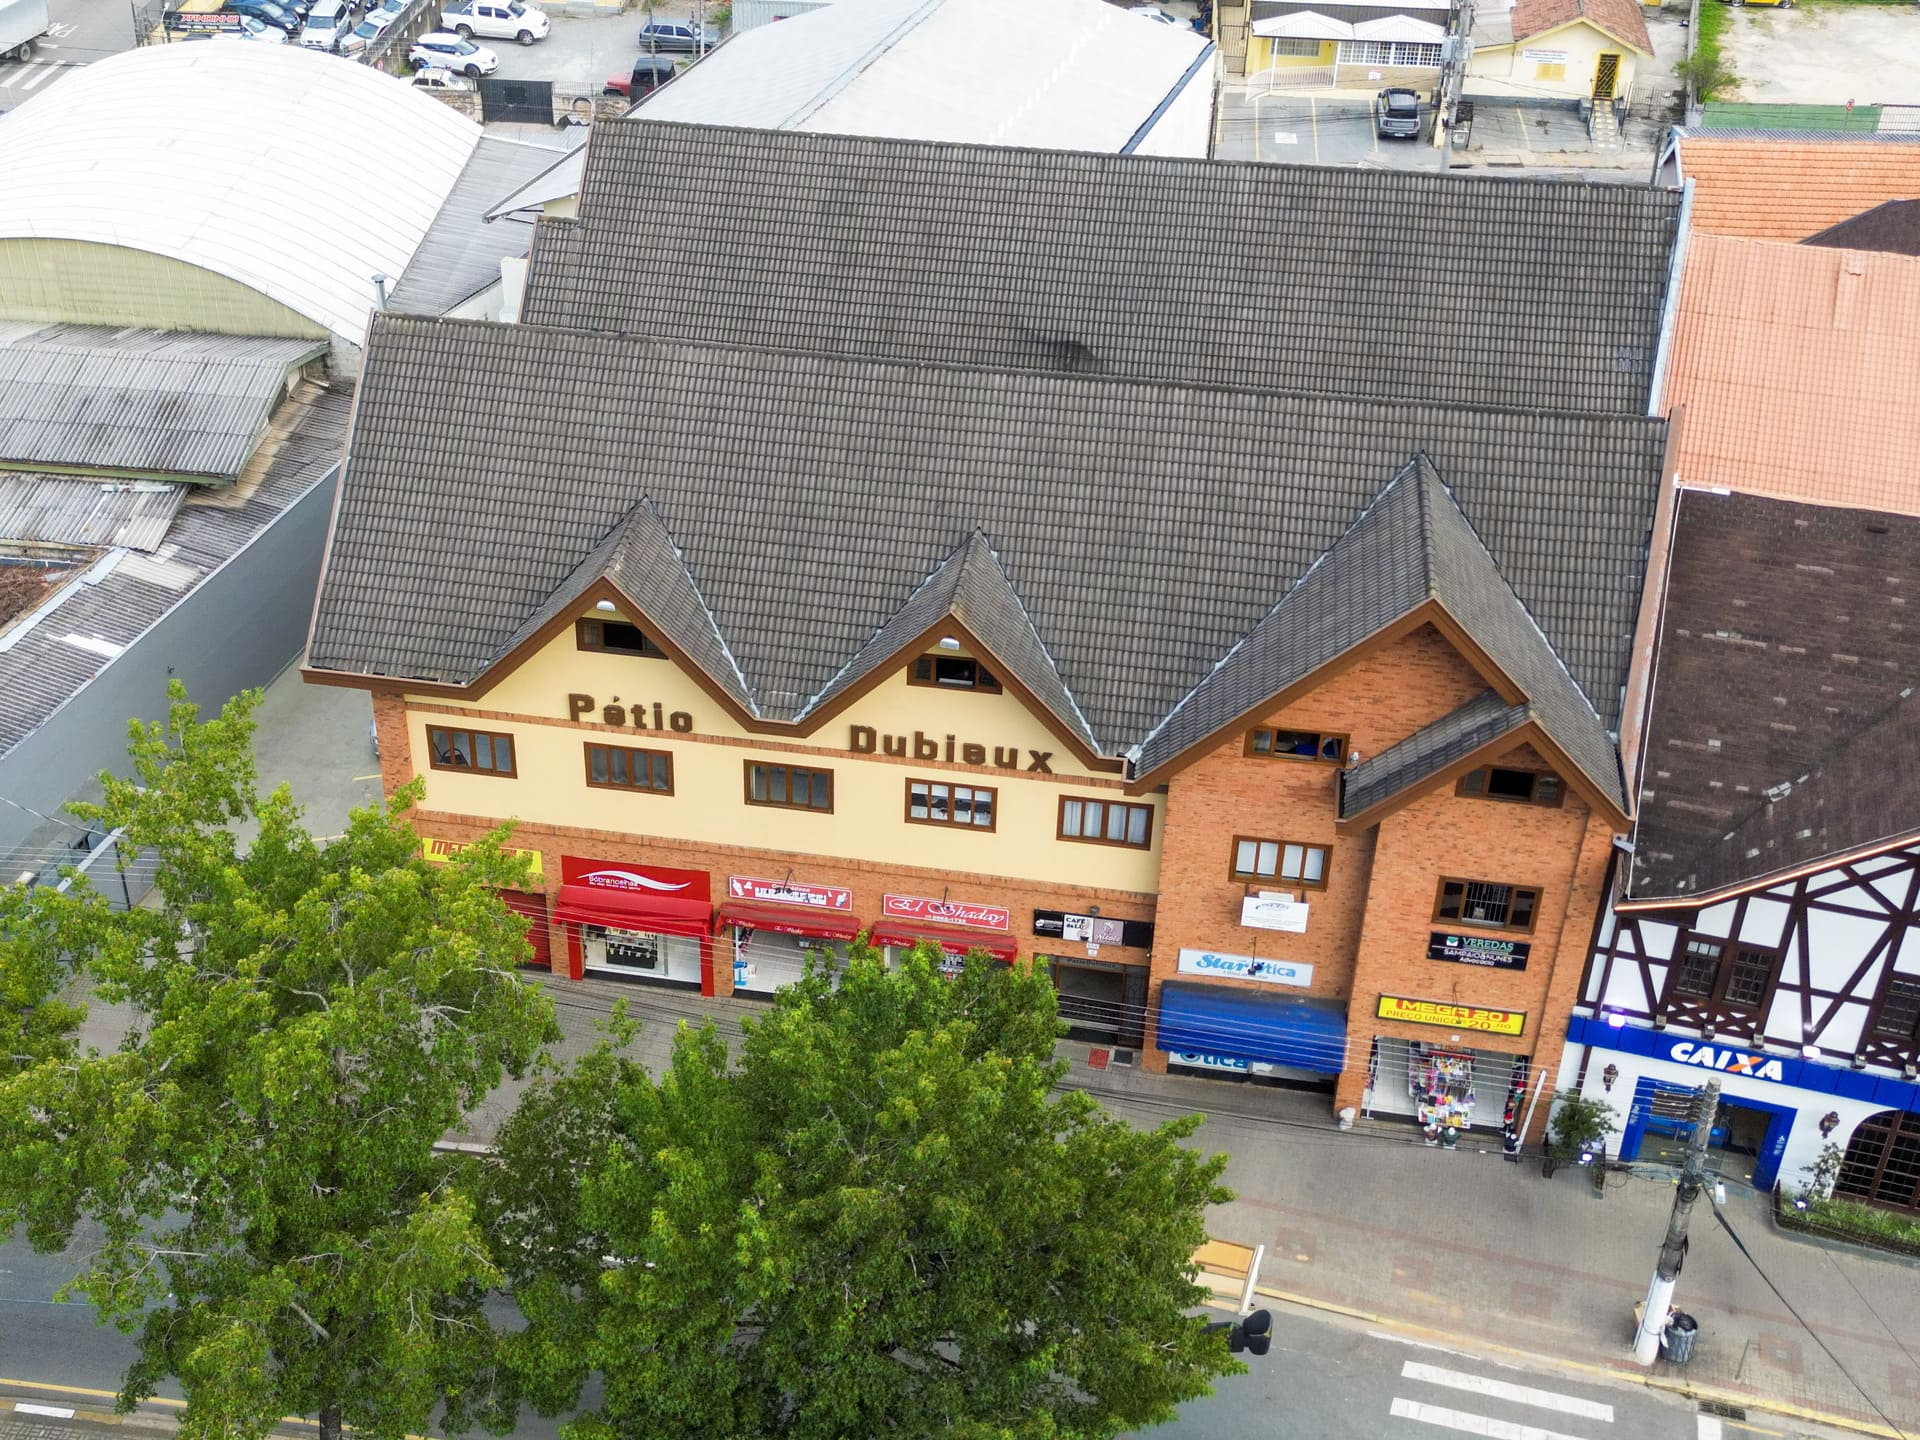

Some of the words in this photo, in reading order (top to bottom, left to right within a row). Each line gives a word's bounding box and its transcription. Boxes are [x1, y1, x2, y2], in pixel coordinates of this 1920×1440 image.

[568, 693, 693, 733] Pátio
[1462, 936, 1514, 951] VEREDAS
[1196, 954, 1249, 972] Star
[1401, 999, 1470, 1019] MEGA
[1473, 1009, 1505, 1023] 20
[1670, 1042, 1783, 1081] CAIXA
